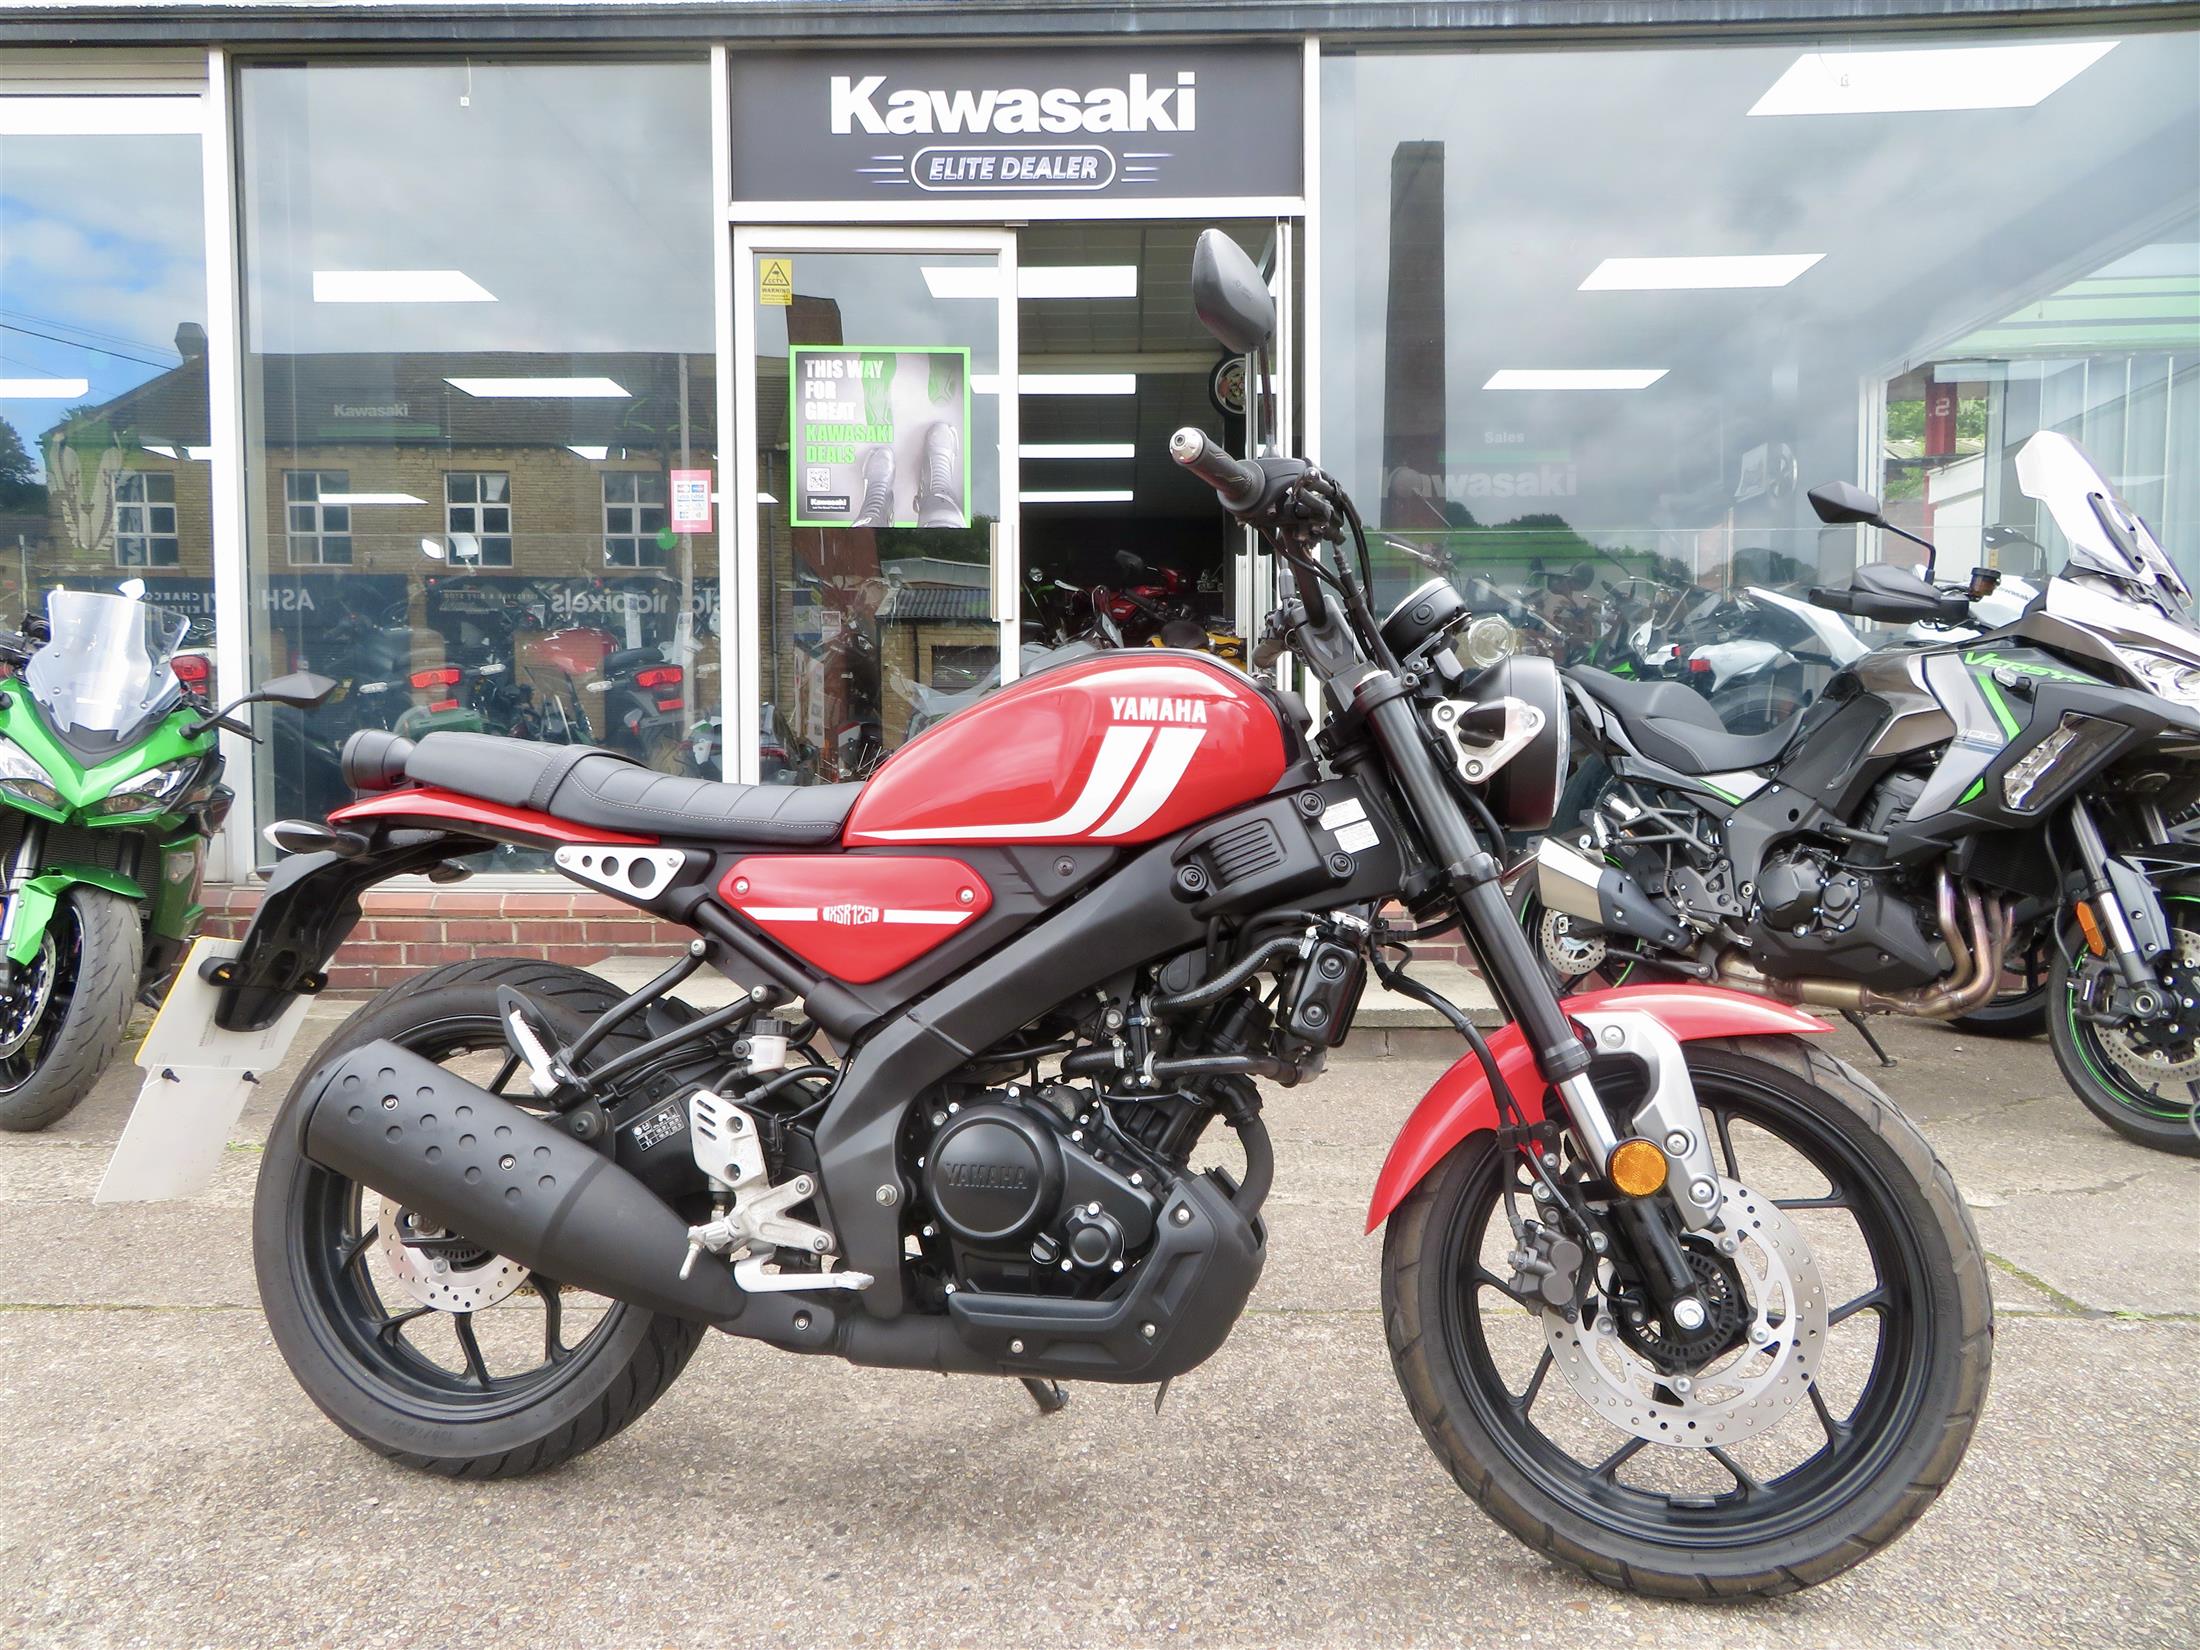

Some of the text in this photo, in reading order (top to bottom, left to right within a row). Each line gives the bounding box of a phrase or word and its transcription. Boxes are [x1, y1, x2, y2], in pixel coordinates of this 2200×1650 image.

[830, 72, 1196, 135] Kawasaki
[929, 154, 1099, 181] ELITE DEALER
[805, 359, 884, 379] THIS WAY
[805, 380, 837, 400] FOR
[334, 403, 409, 417] Kawasaki
[805, 401, 857, 421] GREAT
[805, 424, 893, 442] KAWASAKI
[1484, 431, 1525, 444] Sales
[805, 445, 856, 464] DEALS
[1110, 697, 1207, 723] YAMAHA
[946, 1163, 1028, 1189] YAMAHA
